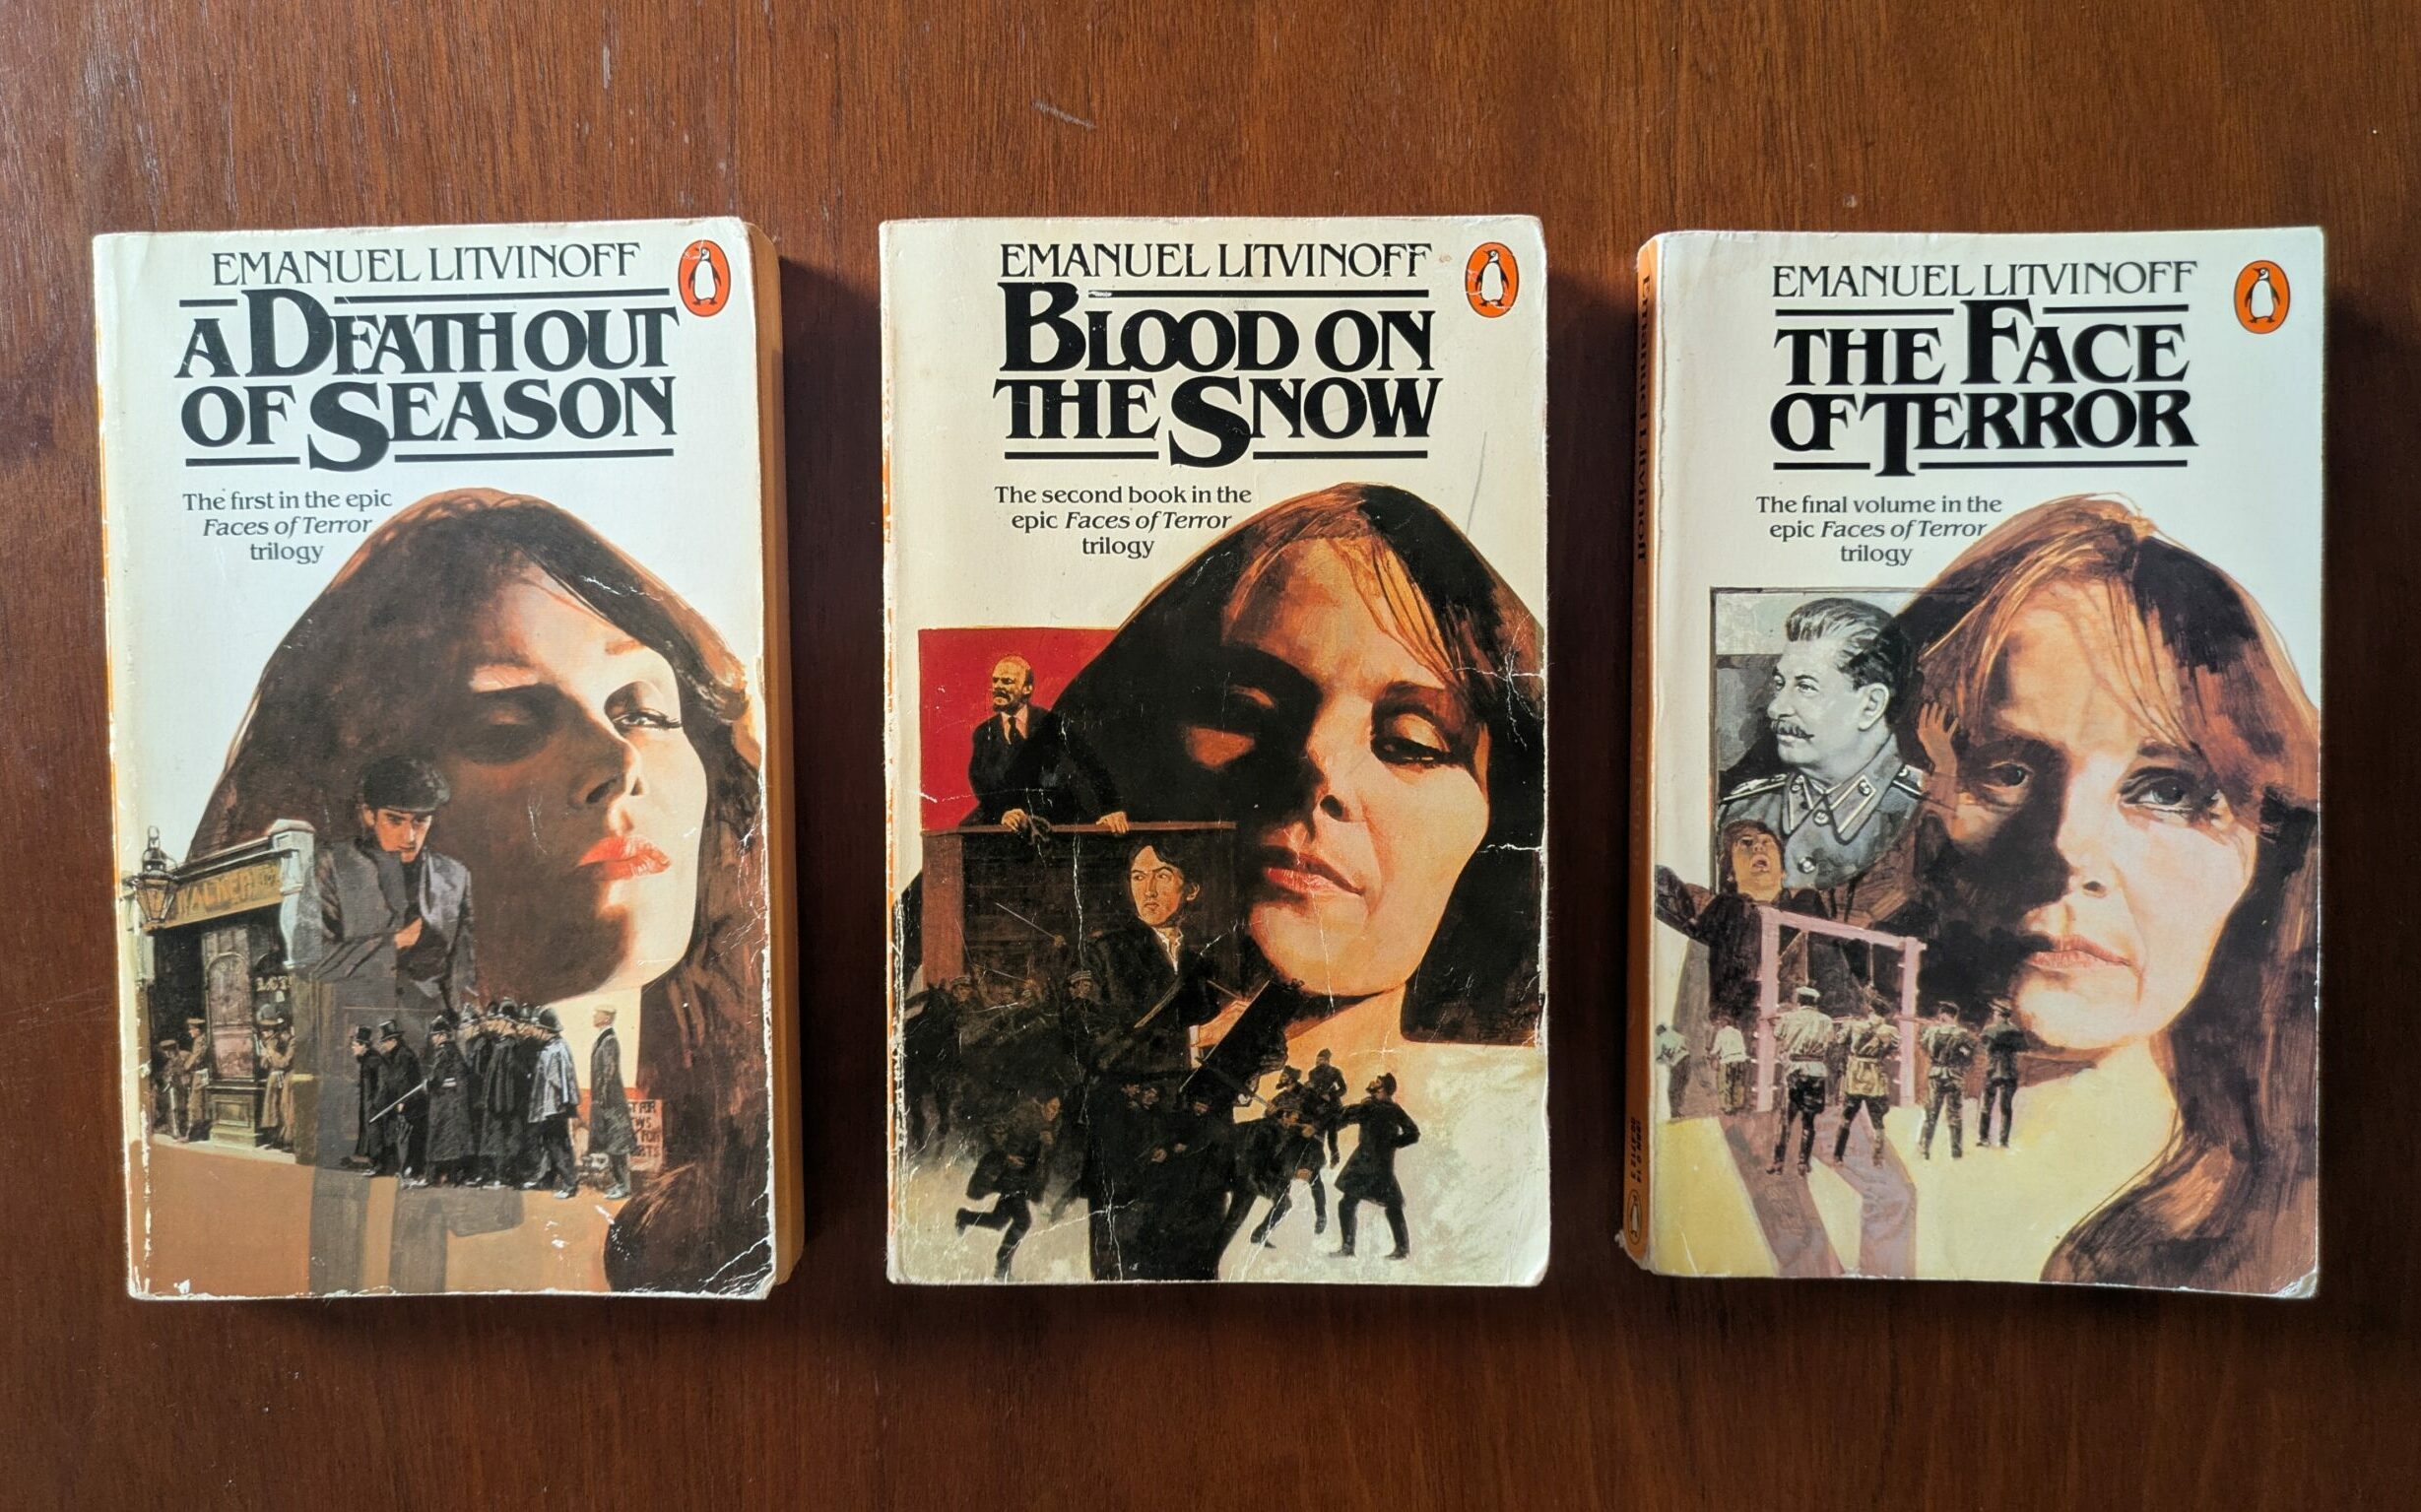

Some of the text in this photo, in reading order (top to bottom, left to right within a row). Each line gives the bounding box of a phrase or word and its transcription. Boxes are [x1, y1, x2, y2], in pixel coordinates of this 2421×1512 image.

[213, 242, 640, 286] EMANUEL LITVINOFF
[1001, 242, 1432, 278] EMANUEL LITVINOFF
[1772, 260, 2197, 297] EMANUEL LITVINOFF
[174, 288, 680, 378] A DEATH OUT
[997, 281, 1436, 373] BLOOD ON
[1773, 297, 2190, 386] THE FACE
[180, 375, 677, 472] OF SEASON
[992, 375, 1444, 469] THE SNOW
[1770, 388, 2199, 478] OF TERROR
[183, 490, 392, 512] The first in the epic
[994, 485, 1252, 503] The second book in the
[1755, 494, 2001, 513] The final volume in the
[204, 517, 370, 538] Faces of Terror
[1012, 510, 1233, 534] epic Faces of Terror
[1769, 519, 1987, 543] epic Faces of Terror
[250, 542, 323, 565] trilogy
[1082, 536, 1155, 559] trilogy
[1841, 544, 1912, 566] trilogy
